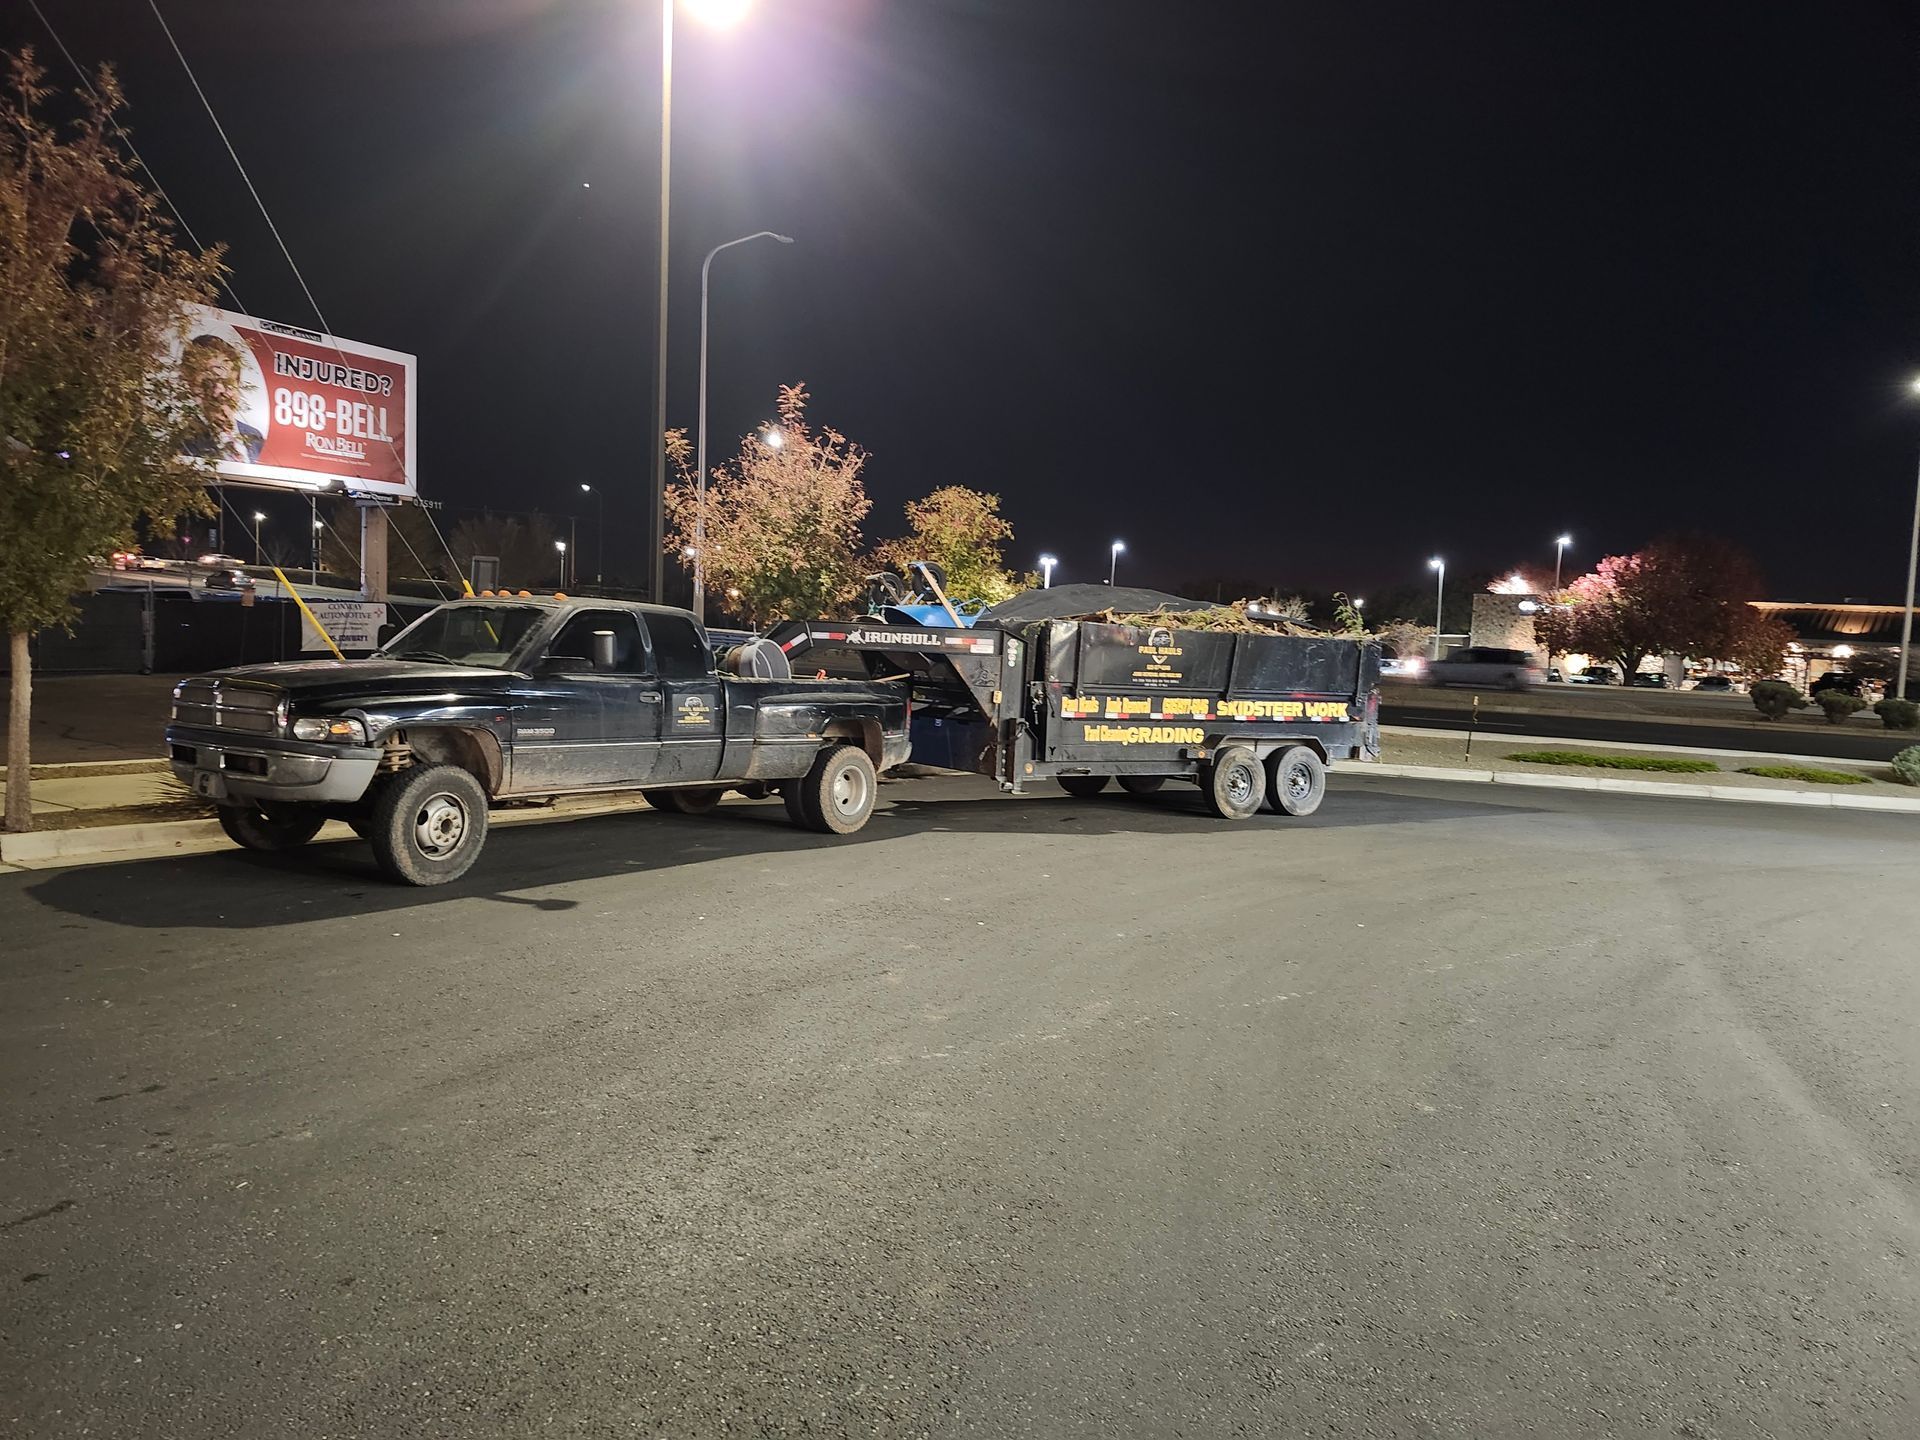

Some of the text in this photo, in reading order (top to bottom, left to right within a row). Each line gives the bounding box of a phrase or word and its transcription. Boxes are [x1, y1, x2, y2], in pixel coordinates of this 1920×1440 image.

[274, 351, 394, 396] INJURED?
[274, 387, 394, 443] 898-BELL
[305, 431, 363, 454] RON BELL
[320, 611, 372, 619] AUTOMOTIVE
[865, 631, 941, 646] IRONBULL
[1217, 700, 1304, 718] SKIDSTEER
[1304, 702, 1349, 718] WORK
[1127, 727, 1205, 744] GRADING
